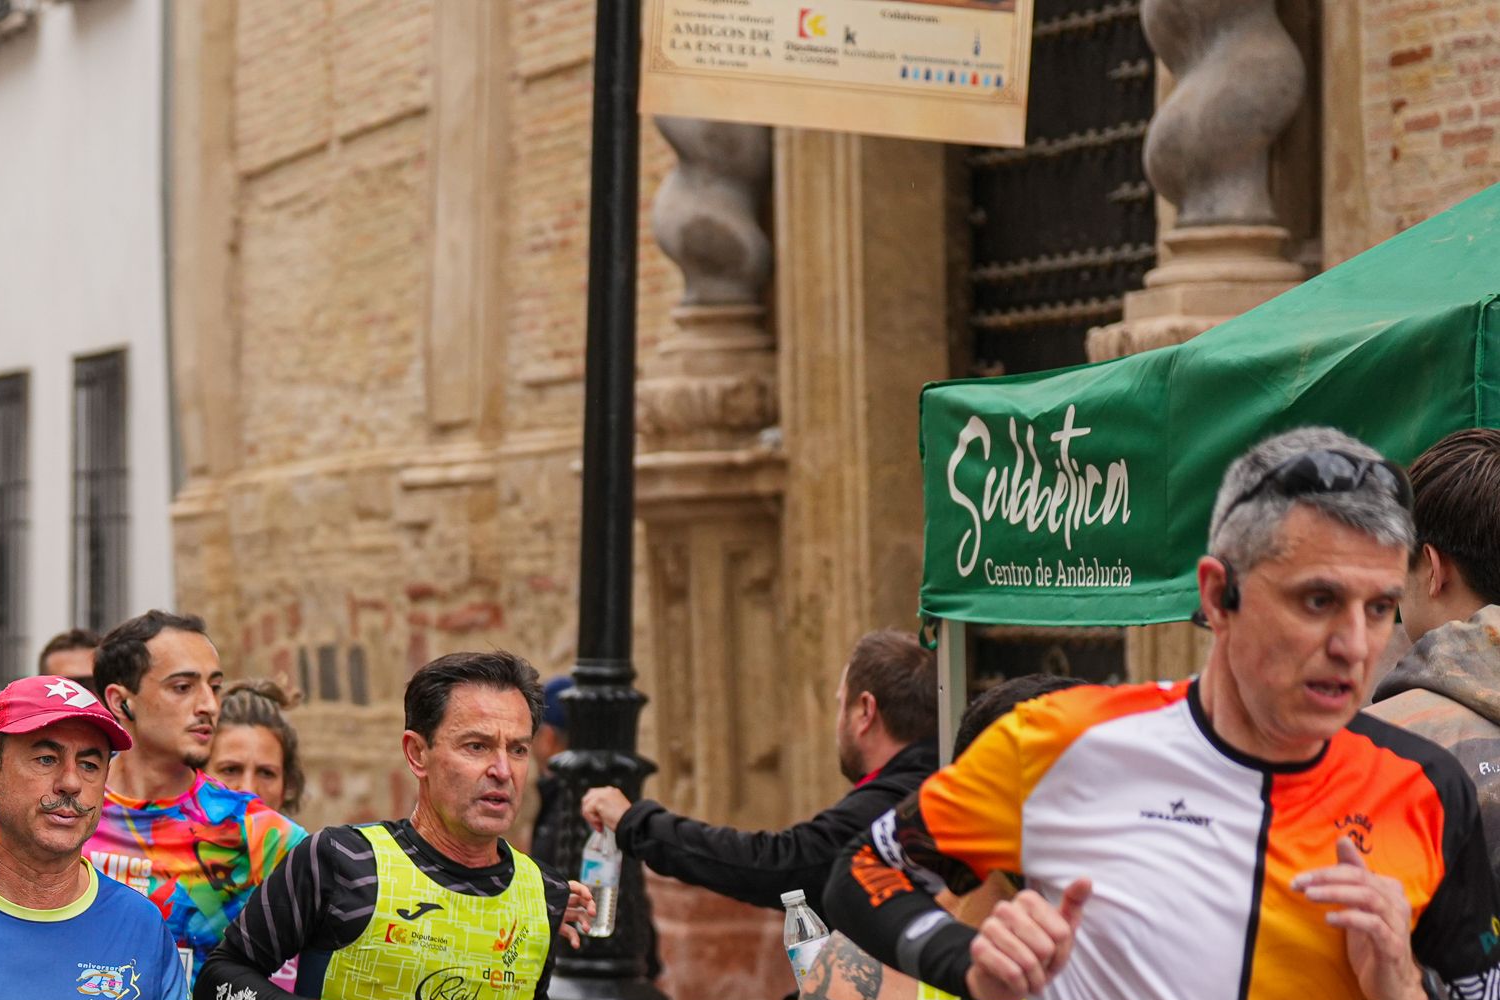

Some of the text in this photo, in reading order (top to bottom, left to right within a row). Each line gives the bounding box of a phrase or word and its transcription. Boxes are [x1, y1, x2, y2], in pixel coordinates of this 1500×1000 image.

[671, 23, 772, 41] AMIGOS DE
[670, 38, 772, 57] LA ESCUELA
[984, 558, 1132, 588] Centro de Andalucía
[411, 931, 448, 944] Diputación
